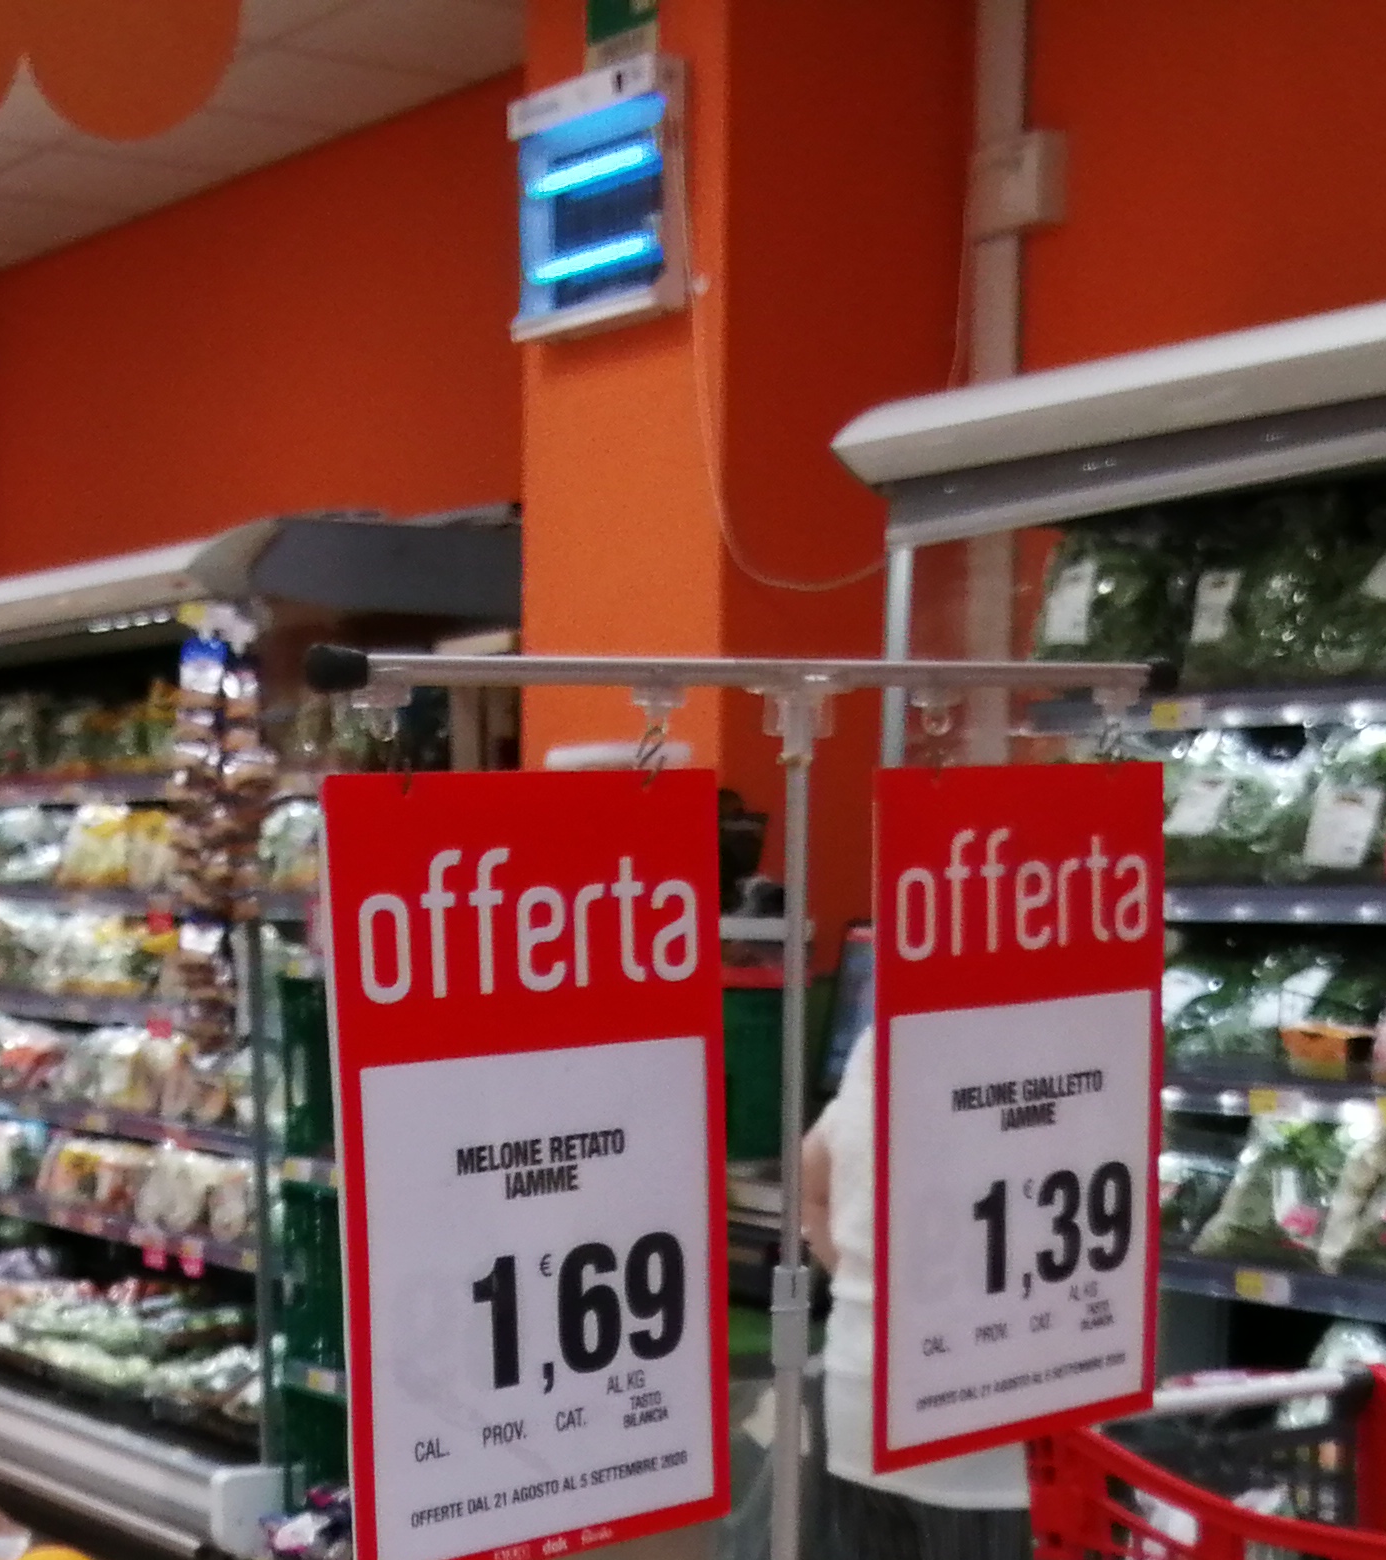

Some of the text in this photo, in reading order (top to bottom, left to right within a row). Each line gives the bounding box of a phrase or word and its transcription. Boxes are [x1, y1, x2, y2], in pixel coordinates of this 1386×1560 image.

[896, 828, 1149, 961] offerta
[358, 847, 699, 1004] offerta
[952, 1070, 1103, 1113] MELONE GIALLETTO
[457, 1129, 626, 1175] MELONE RETATO
[505, 1164, 580, 1200] IAMME
[606, 1369, 646, 1395] AL KG
[414, 1407, 589, 1463] CAL. PROV. CAT.
[411, 1502, 464, 1528] OFFERTE
[467, 1496, 491, 1515] DAL
[494, 1492, 508, 1508] 21
[512, 1480, 559, 1505] AGOSTO
[563, 1476, 578, 1492] AL
[591, 1458, 658, 1485] SETTEMBRE
